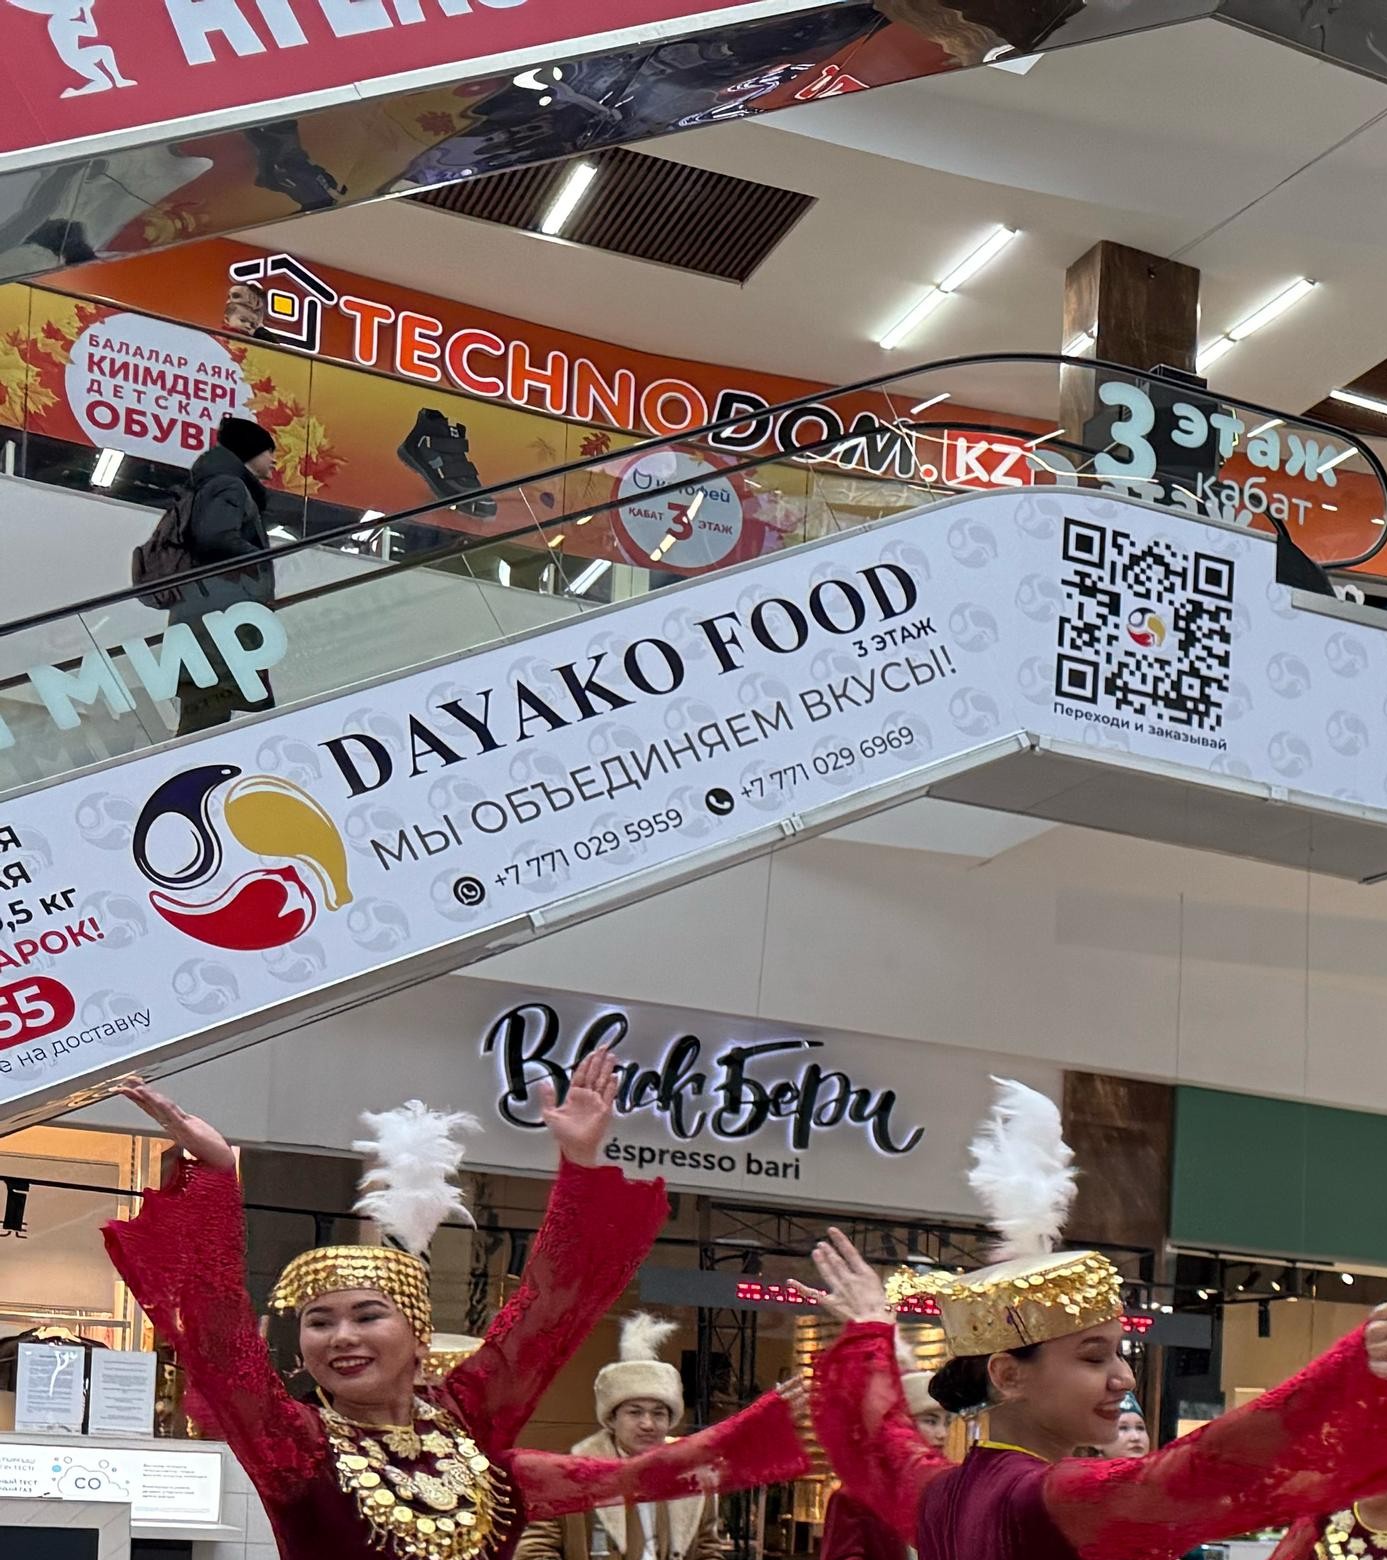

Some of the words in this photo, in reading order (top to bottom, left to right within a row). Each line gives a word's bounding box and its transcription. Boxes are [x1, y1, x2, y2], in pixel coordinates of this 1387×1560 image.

[88, 333, 188, 370] БАЛАЛАР
[87, 352, 236, 409] КИІМДЕРІ
[1094, 382, 1157, 480] 3
[1171, 402, 1338, 487] этаж
[665, 502, 693, 541] 3
[698, 520, 733, 535] ЭТАЖ
[852, 640, 868, 657] 3
[870, 617, 937, 651] ЭТАЖ
[318, 638, 686, 799] DAYAKO
[694, 562, 918, 677] FOOD
[1053, 702, 1130, 729] Переходи
[1134, 721, 1145, 733] и
[1148, 724, 1228, 750] заказывай
[370, 814, 463, 872] МЫ
[470, 701, 795, 834] ОБЪЕДИНЯЕМ
[799, 645, 957, 723] ВКУСЫ!
[740, 776, 766, 800] +7
[813, 750, 856, 777] 029
[859, 726, 915, 759] 6969
[494, 864, 522, 889] +7
[573, 831, 622, 861] 029
[624, 808, 684, 843] 5959
[0, 861, 32, 890] Я
[39, 887, 76, 916] кг
[17, 1042, 48, 1067] на
[51, 1007, 151, 1058] доставку
[746, 1154, 801, 1180] bari
[74, 1476, 102, 1490] CO
